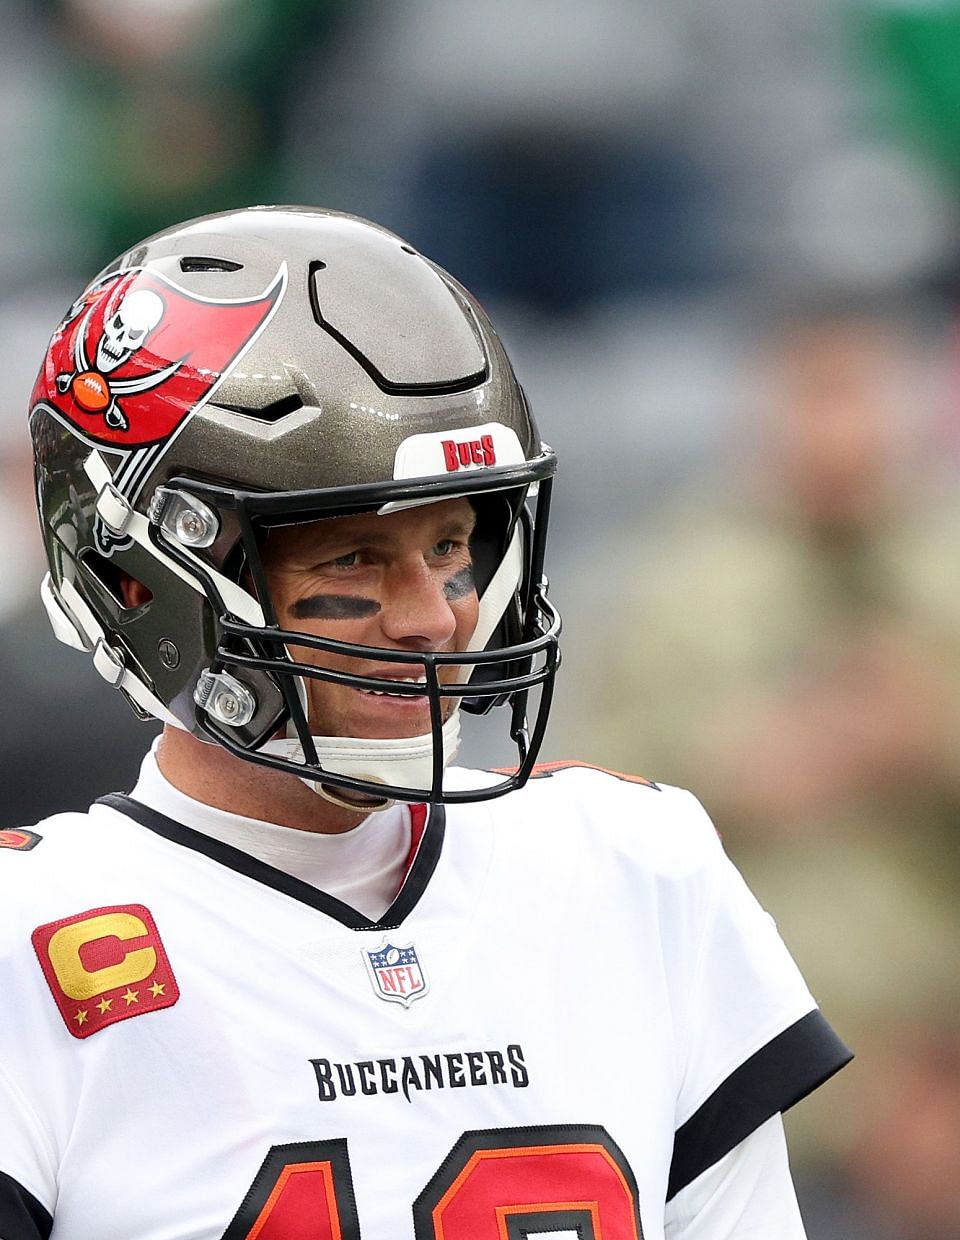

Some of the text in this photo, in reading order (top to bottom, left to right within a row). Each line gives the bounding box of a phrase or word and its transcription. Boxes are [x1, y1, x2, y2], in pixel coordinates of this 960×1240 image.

[440, 434, 496, 472] BUCS
[48, 912, 157, 1001] C
[378, 966, 421, 994] NFL
[308, 1044, 529, 1103] BUCCANEERS
